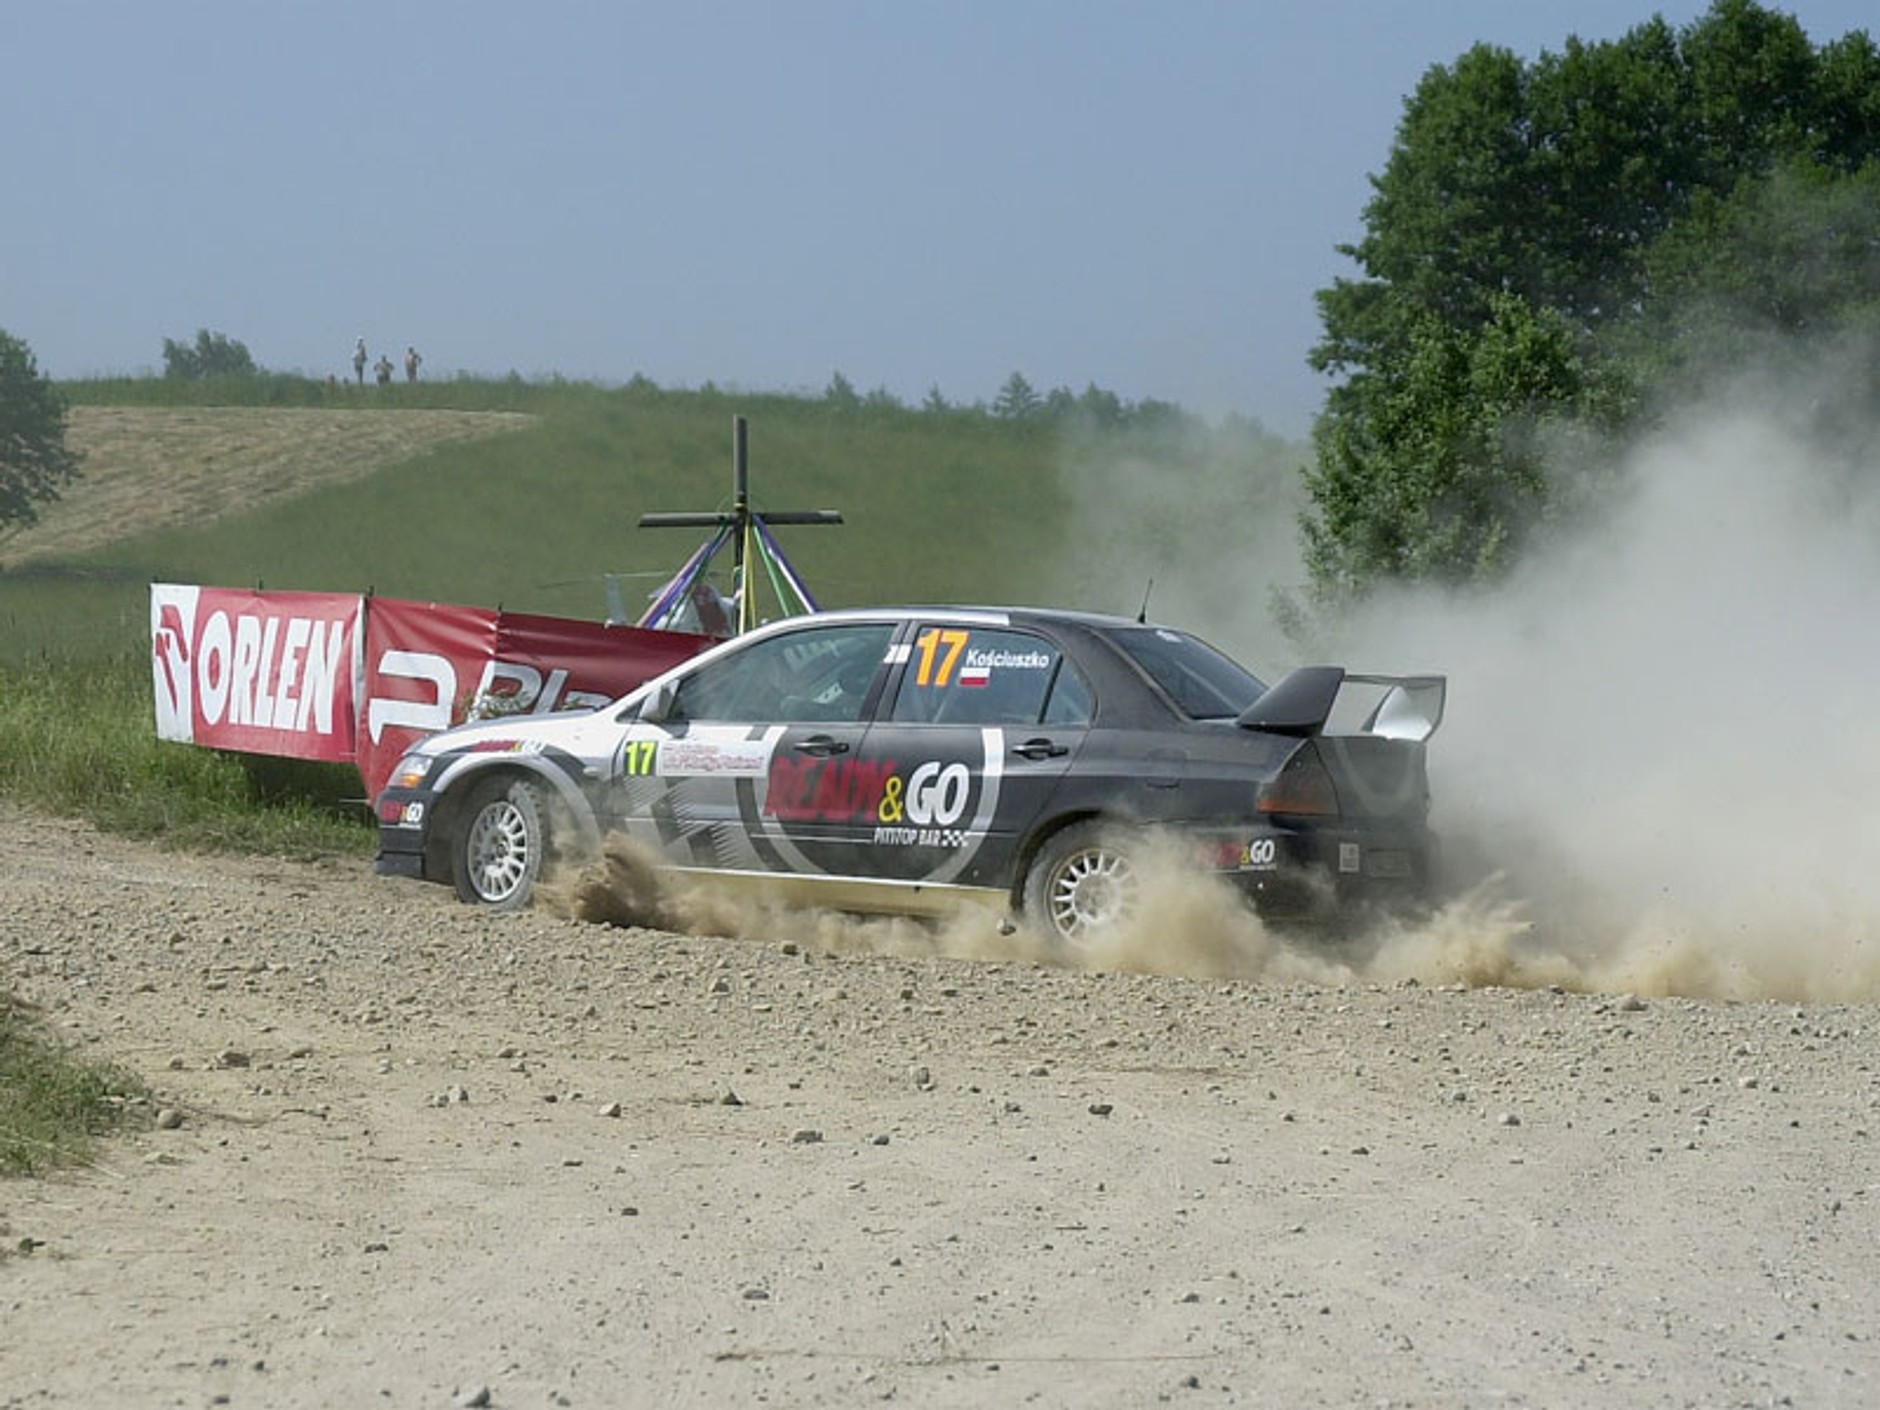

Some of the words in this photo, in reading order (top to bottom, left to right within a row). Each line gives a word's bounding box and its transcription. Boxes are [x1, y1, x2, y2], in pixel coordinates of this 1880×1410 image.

[197, 610, 344, 734] ORLEN
[916, 628, 969, 687] 17
[965, 648, 1049, 668] Kościuszko
[626, 741, 656, 775] 17
[905, 762, 970, 825] GO
[1250, 839, 1275, 864] GO
